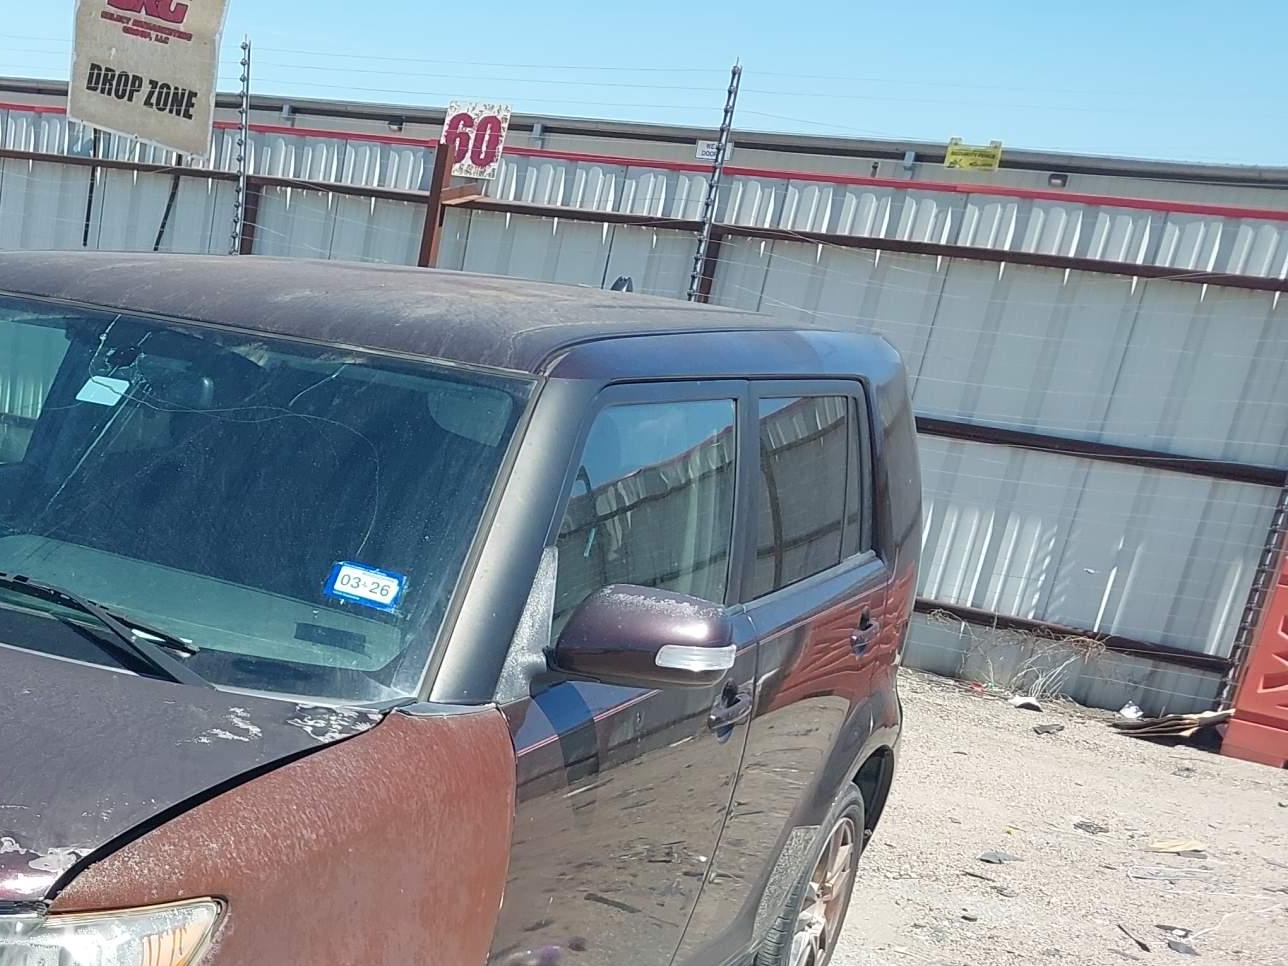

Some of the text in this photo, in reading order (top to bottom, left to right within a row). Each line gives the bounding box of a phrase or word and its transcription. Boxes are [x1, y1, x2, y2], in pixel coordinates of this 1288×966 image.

[86, 62, 198, 120] DROP ZONE
[445, 112, 502, 168] 60
